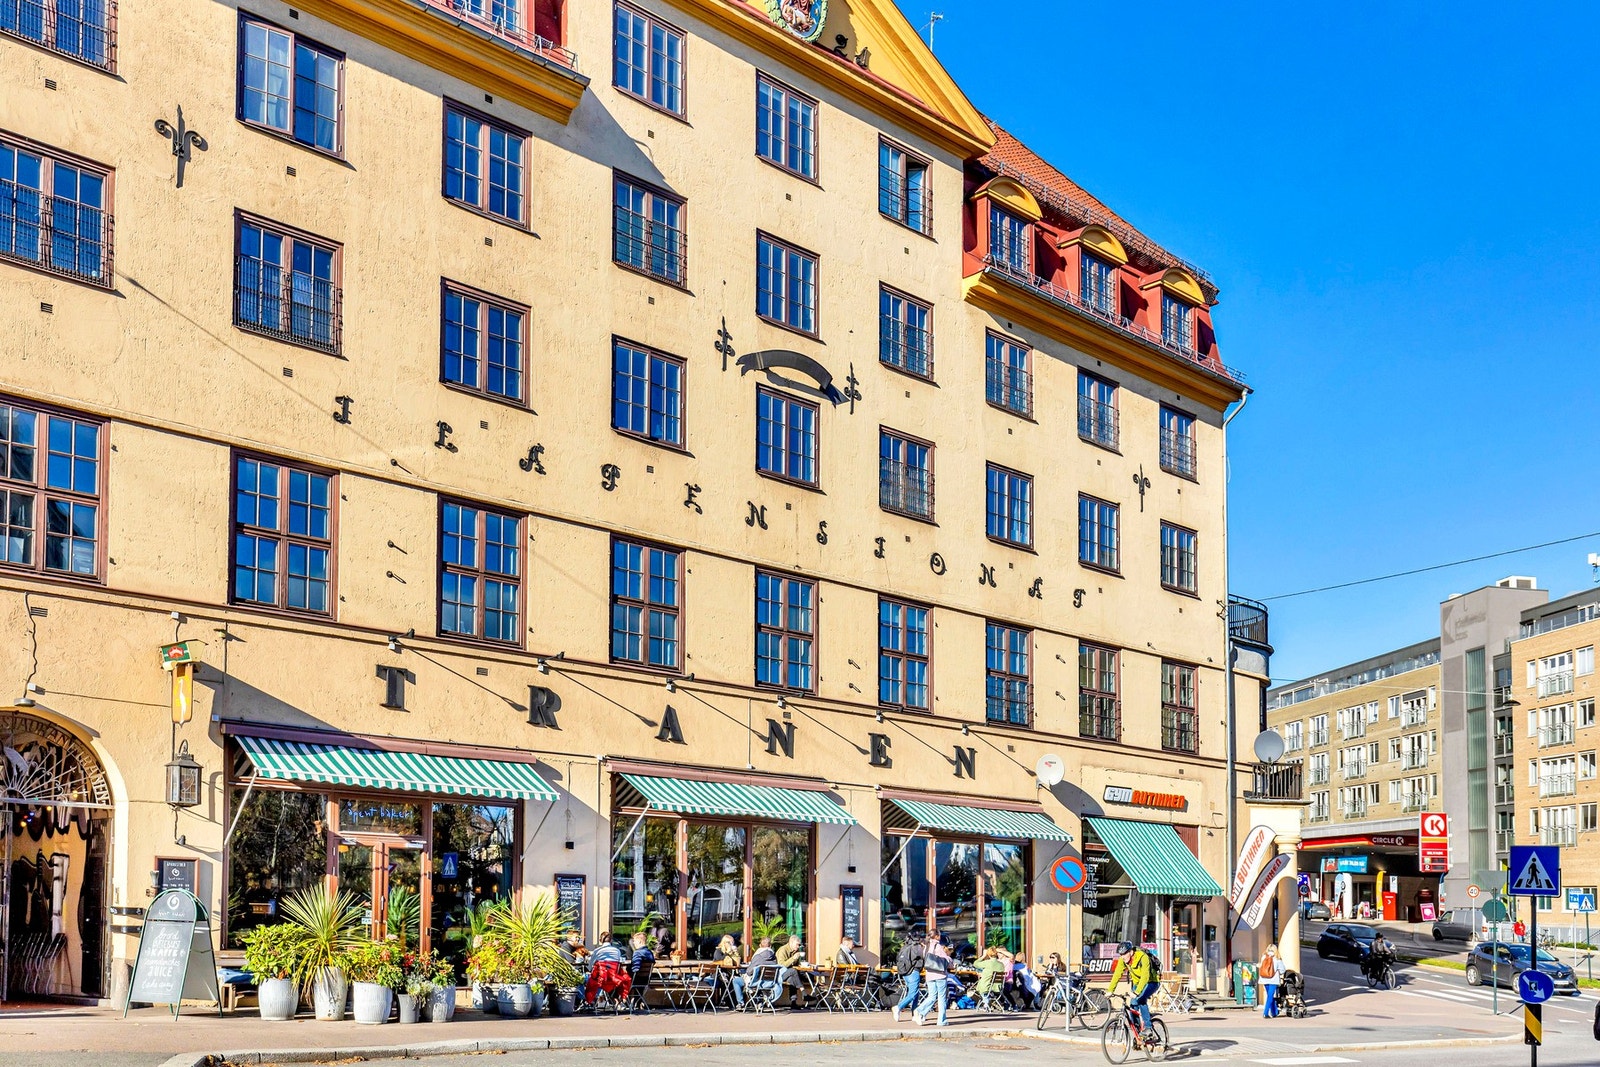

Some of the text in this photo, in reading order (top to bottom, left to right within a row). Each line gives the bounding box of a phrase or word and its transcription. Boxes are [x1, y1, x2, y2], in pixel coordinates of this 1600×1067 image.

[375, 664, 977, 780] TRANEN
[1430, 818, 1444, 833] K
[1396, 837, 1404, 846] K
[1083, 891, 1098, 900] TRY
[1083, 899, 1098, 909] ING
[147, 965, 174, 977] JUICE
[1089, 959, 1112, 972] GYM
